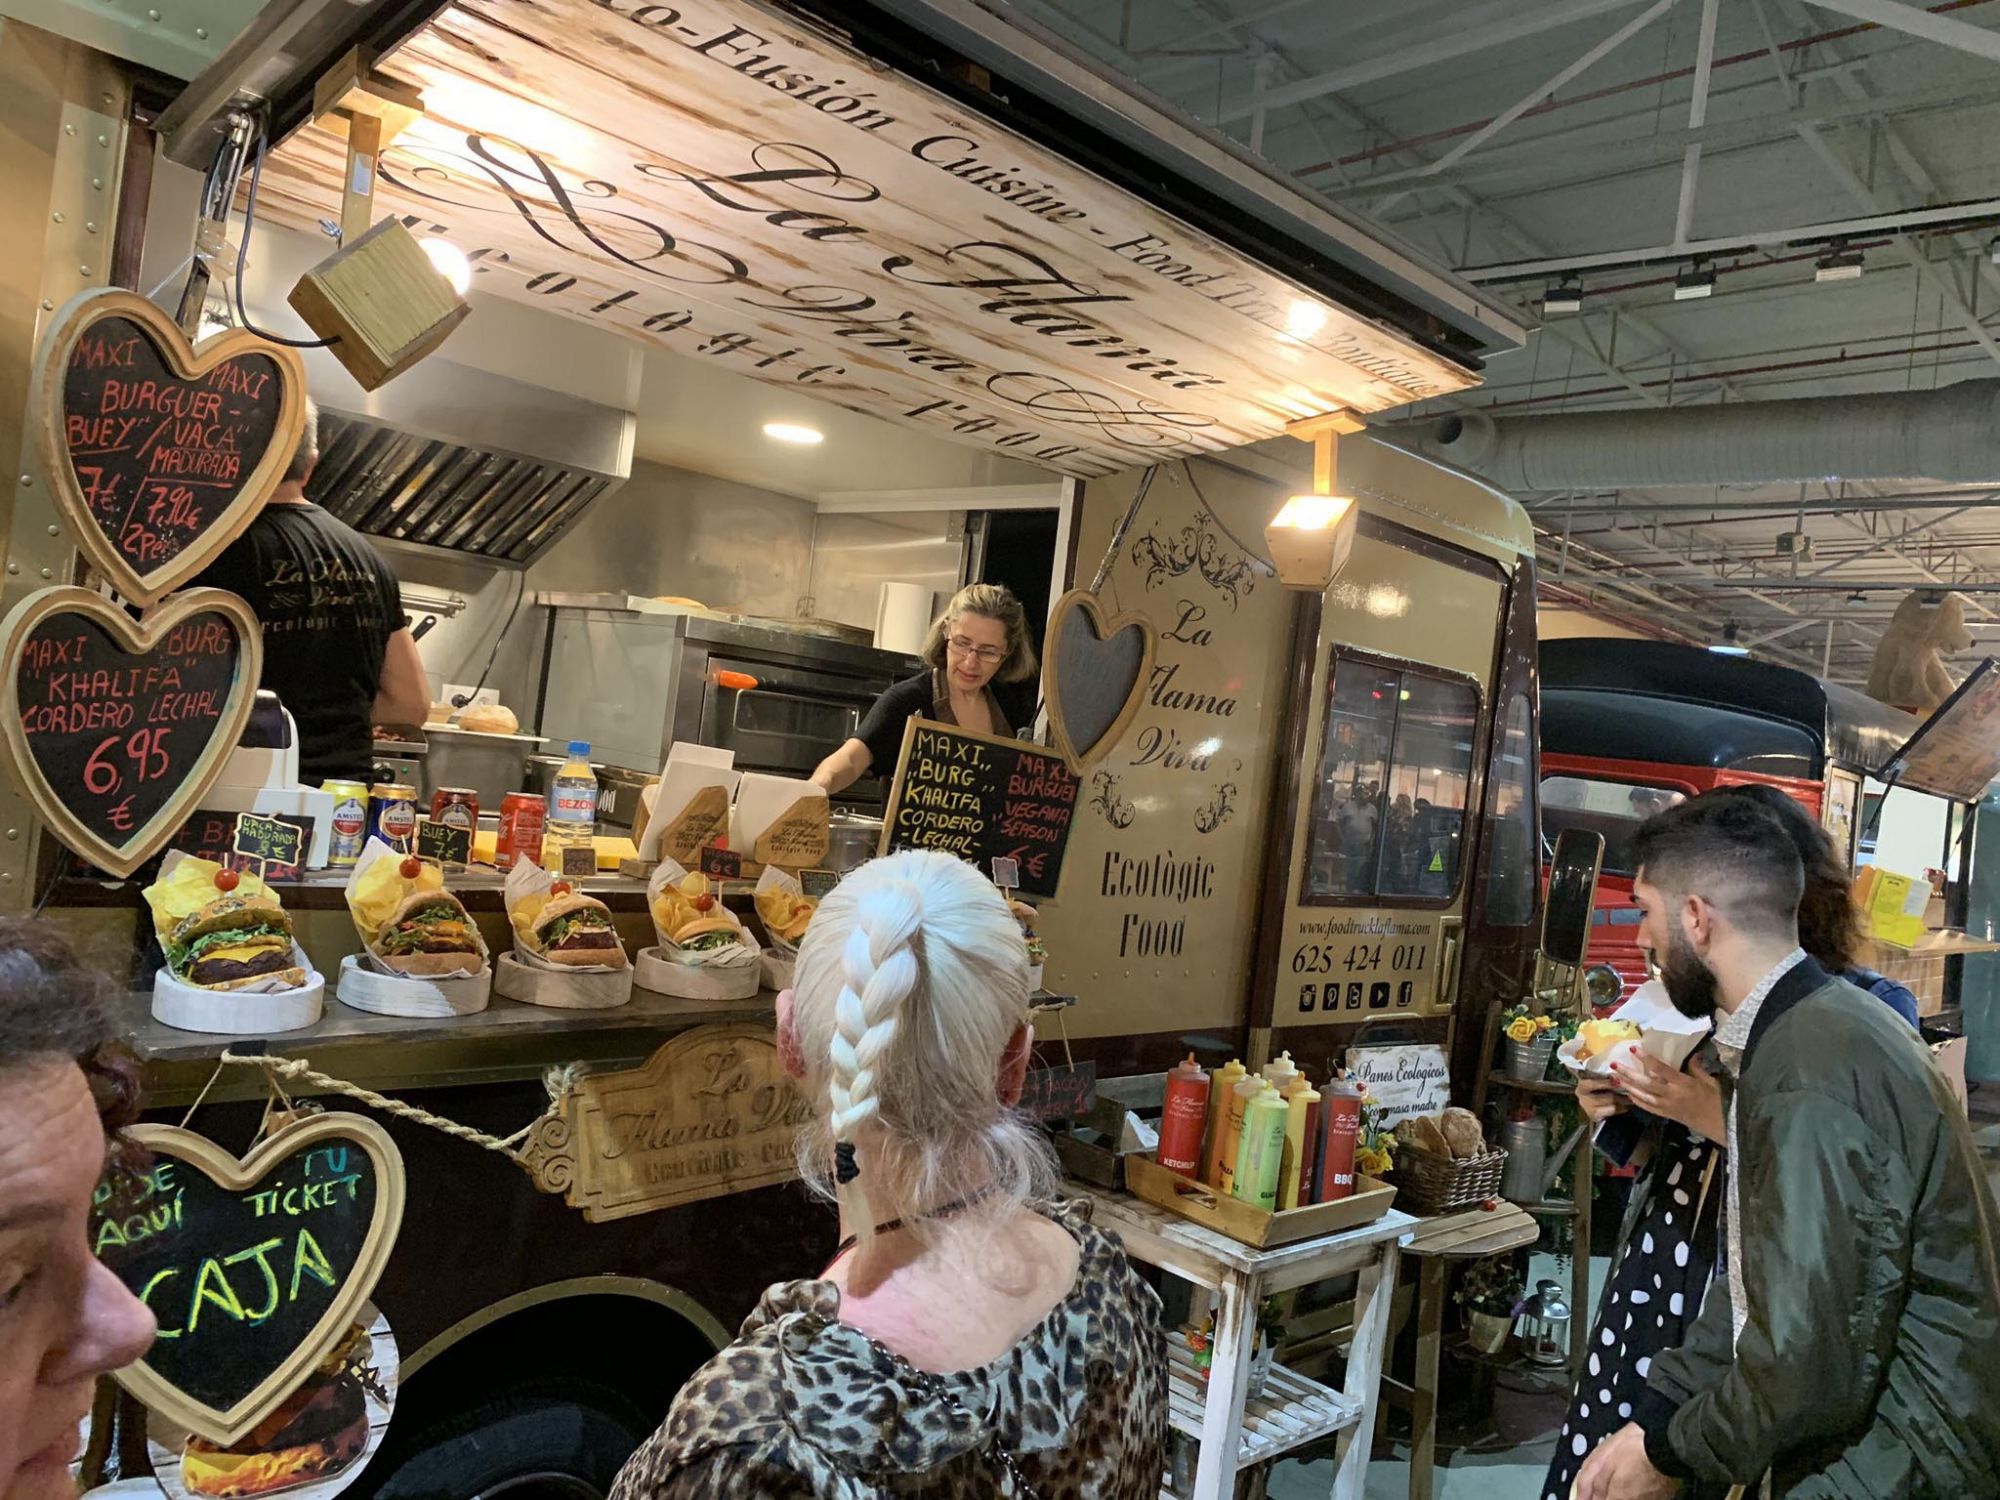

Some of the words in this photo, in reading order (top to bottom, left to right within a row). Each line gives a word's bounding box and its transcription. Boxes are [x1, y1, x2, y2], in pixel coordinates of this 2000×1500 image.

[633, 141, 881, 243] La
[911, 135, 1087, 225] Cuisine
[1106, 230, 1236, 287] Food
[402, 213, 845, 384] cològic
[72, 338, 140, 368] MAXI
[208, 364, 270, 400] MAXI
[102, 379, 222, 423] BURGUER
[150, 446, 241, 480] MADURADA
[167, 622, 231, 656] BURG
[1161, 599, 1212, 647] La
[21, 636, 88, 668] MAXI
[22, 701, 134, 735] CORDERO
[147, 689, 221, 723] LECHAL
[83, 728, 172, 796] 6,95
[917, 731, 985, 767] MAXI
[1130, 726, 1212, 773] Viva
[1016, 753, 1071, 783] MAXI
[106, 794, 137, 831] €
[900, 808, 984, 834] CORDERO
[422, 823, 458, 842] BUEY
[1101, 850, 1215, 904] Ecològic
[1119, 913, 1186, 958] Food
[1292, 942, 1334, 974] 625
[1343, 943, 1382, 972] 424
[1391, 943, 1427, 972] 011
[1358, 1058, 1394, 1083] Panes
[1411, 1091, 1438, 1112] madre
[298, 1147, 348, 1177] TU
[1163, 1157, 1196, 1170] KETCHUP
[1334, 1173, 1353, 1187] BBQ
[94, 1164, 176, 1214] PDE
[95, 1187, 185, 1256] AQUÍ
[138, 1228, 337, 1339] CAJA
